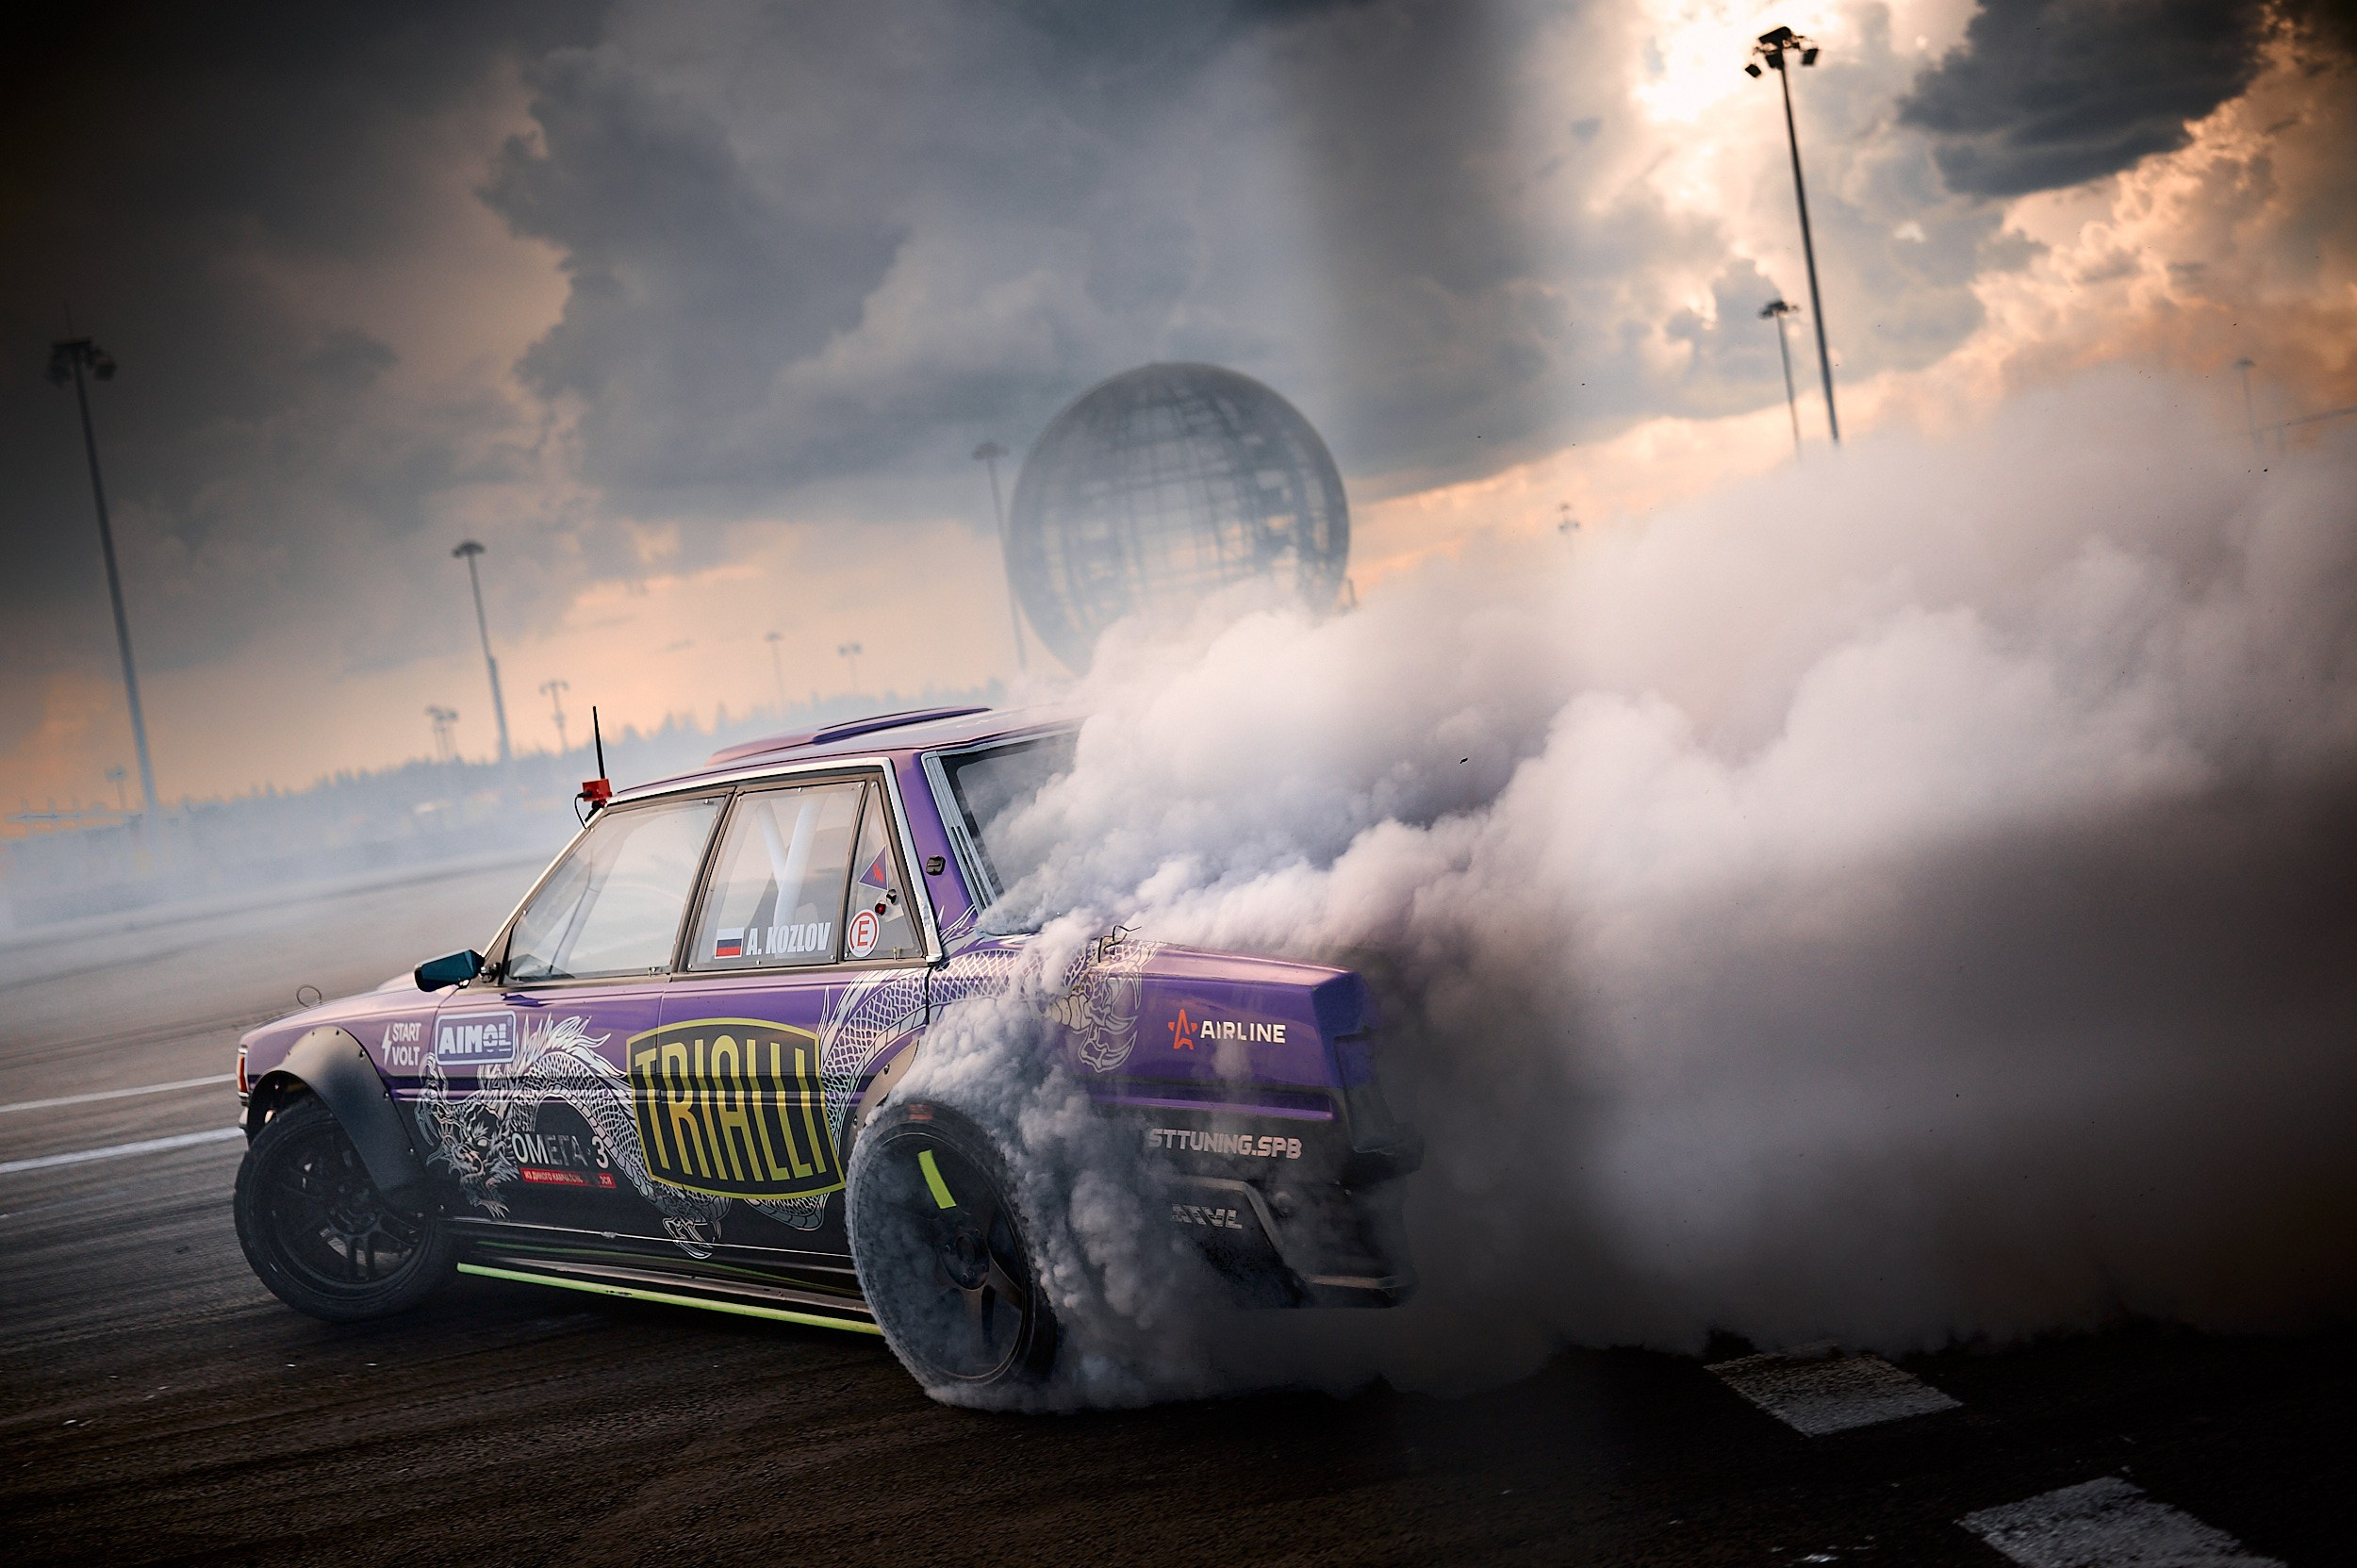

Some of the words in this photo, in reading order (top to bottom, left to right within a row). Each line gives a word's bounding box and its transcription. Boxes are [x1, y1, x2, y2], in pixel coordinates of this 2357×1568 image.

[745, 928, 763, 956] A.
[765, 921, 832, 955] KOZLOV
[857, 919, 870, 947] E
[391, 1022, 421, 1043] START
[438, 1023, 512, 1055] AIMOL
[1199, 1020, 1286, 1044] AIRLINE
[391, 1046, 420, 1066] VOLT
[635, 1034, 827, 1182] TRIALLI
[1148, 1128, 1303, 1160] STTUNING.SPB
